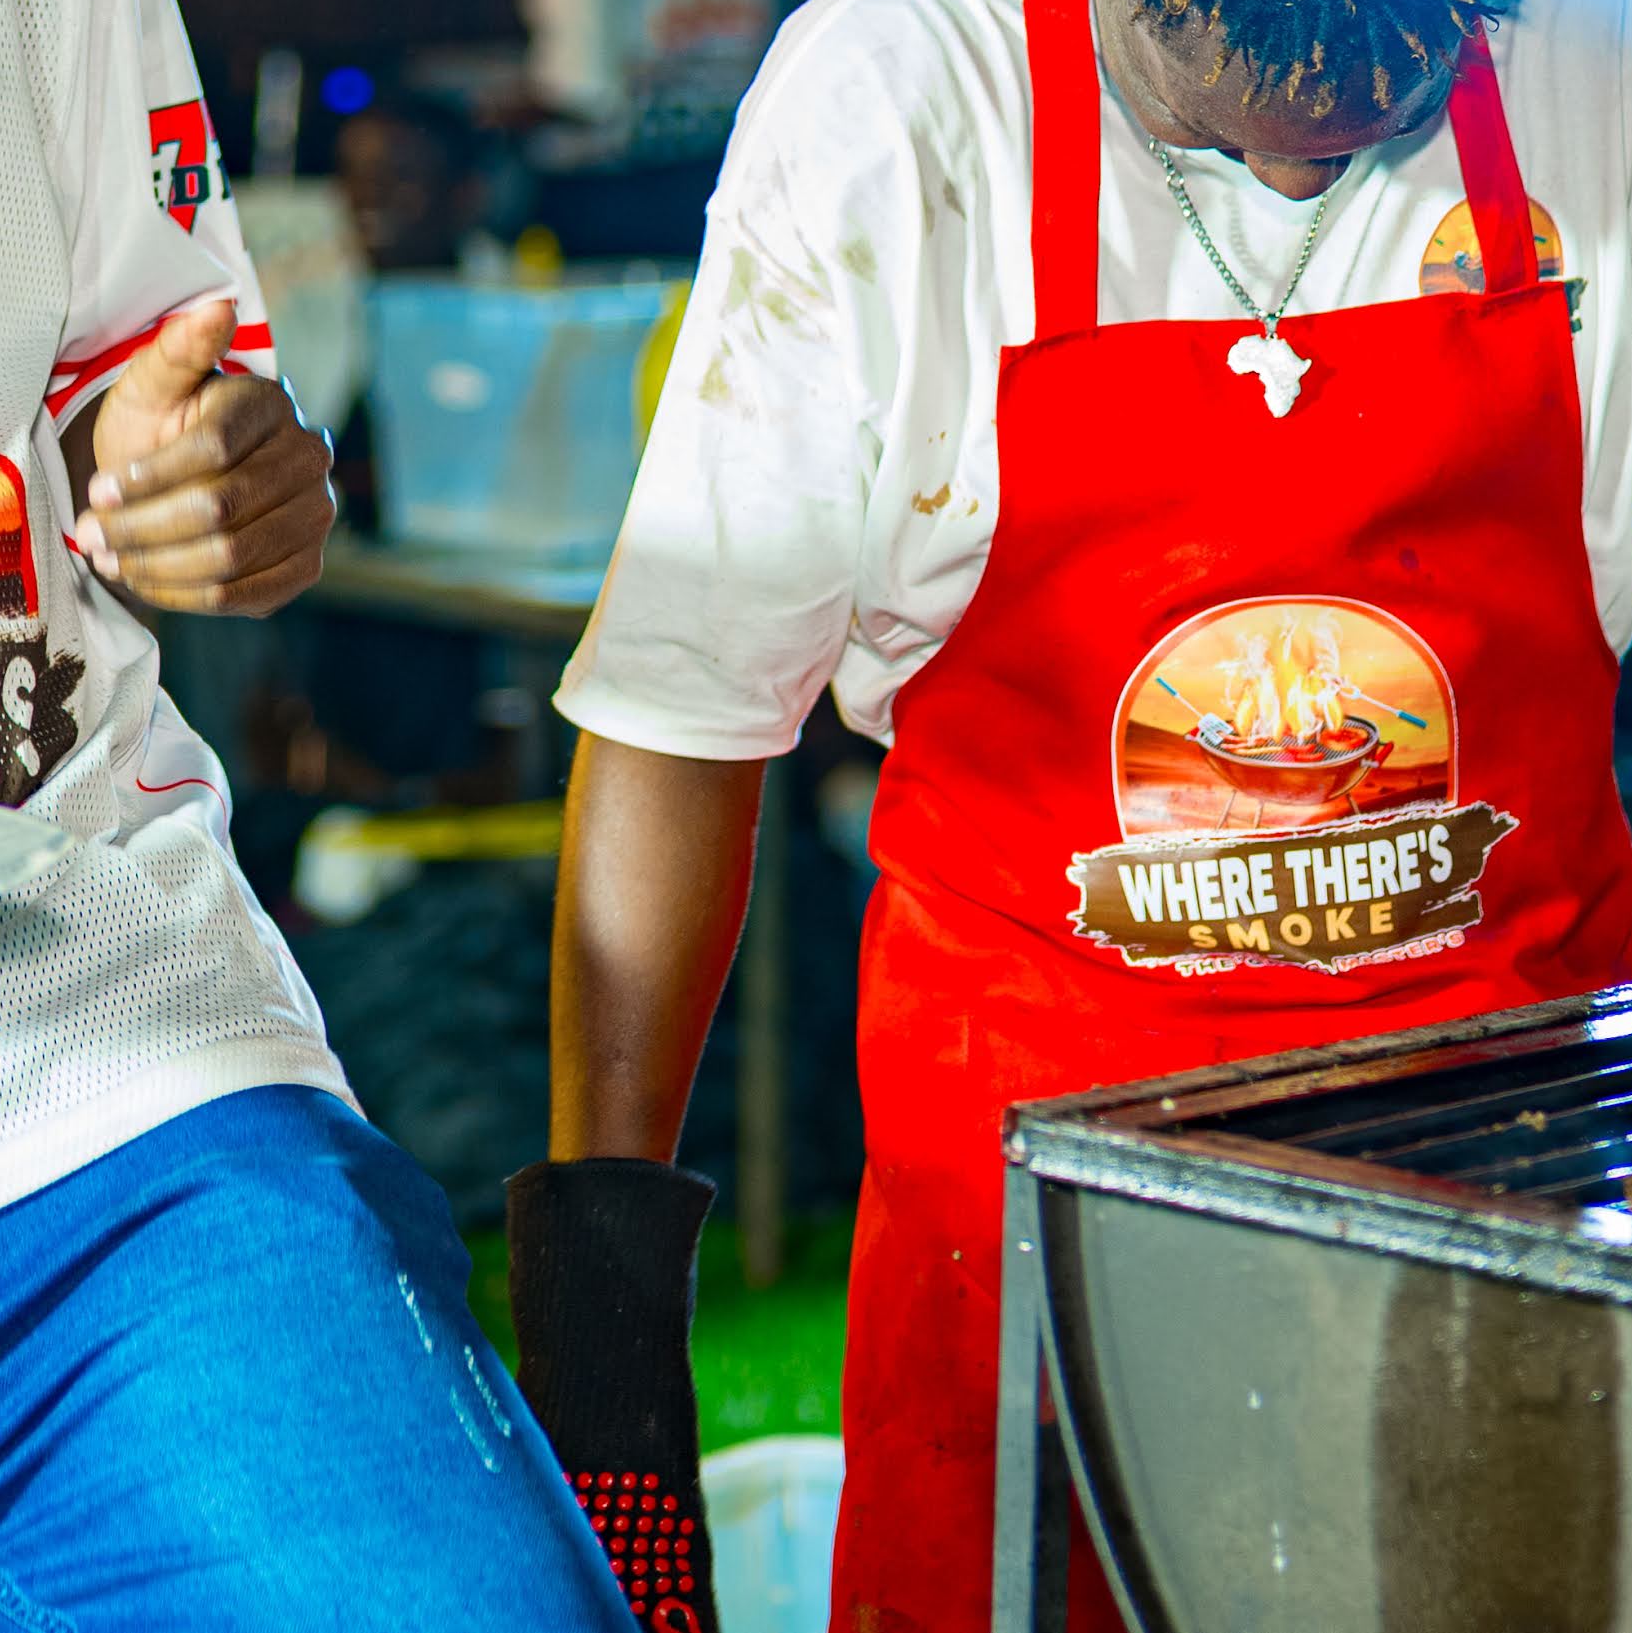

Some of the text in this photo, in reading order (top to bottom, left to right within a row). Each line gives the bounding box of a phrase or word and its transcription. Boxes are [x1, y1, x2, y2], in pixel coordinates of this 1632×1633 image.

[1118, 823, 1453, 923] WHERE THERE'S
[1188, 901, 1395, 951] SMOKE
[1178, 957, 1235, 975] THE
